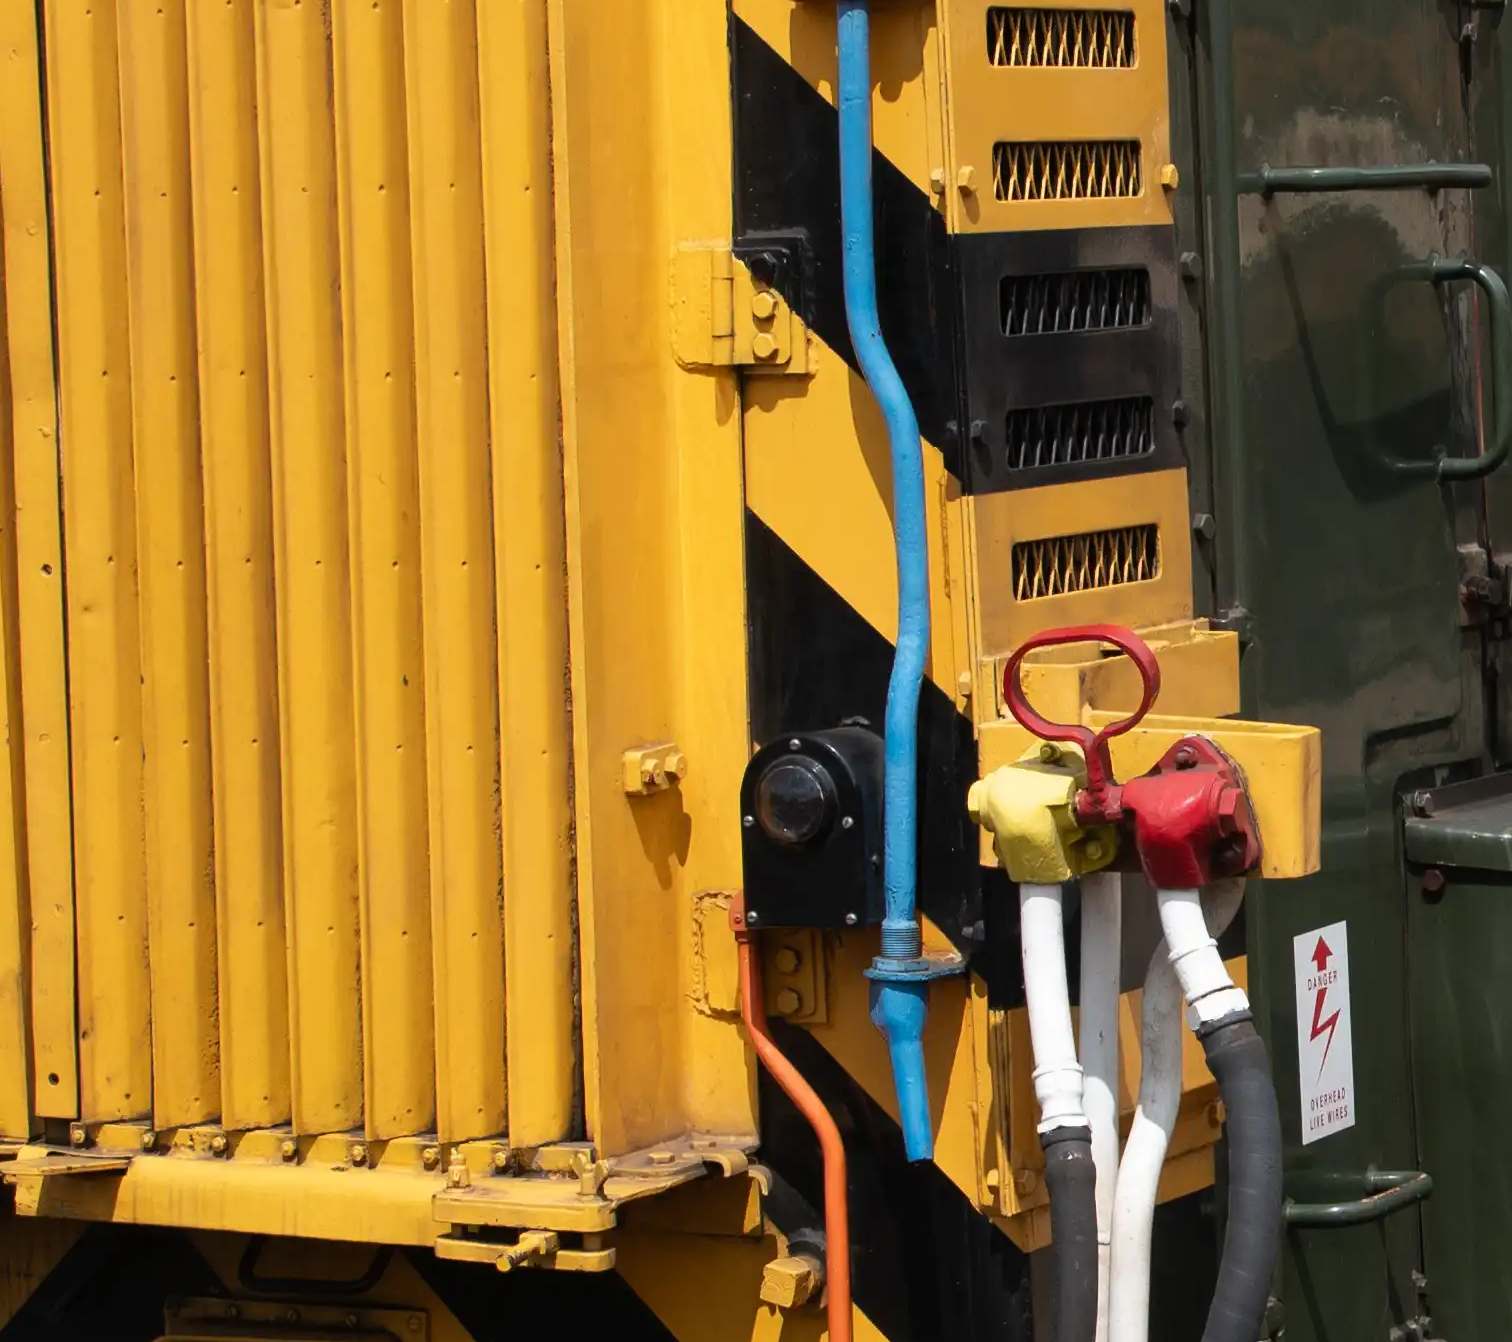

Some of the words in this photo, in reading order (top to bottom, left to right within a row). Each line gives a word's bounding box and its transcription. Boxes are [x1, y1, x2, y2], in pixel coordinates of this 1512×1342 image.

[1307, 970, 1338, 991] DANGER
[1310, 1087, 1346, 1111] OVERHEAD
[1310, 1114, 1325, 1131] LIVE
[1327, 1105, 1349, 1125] WIRES
